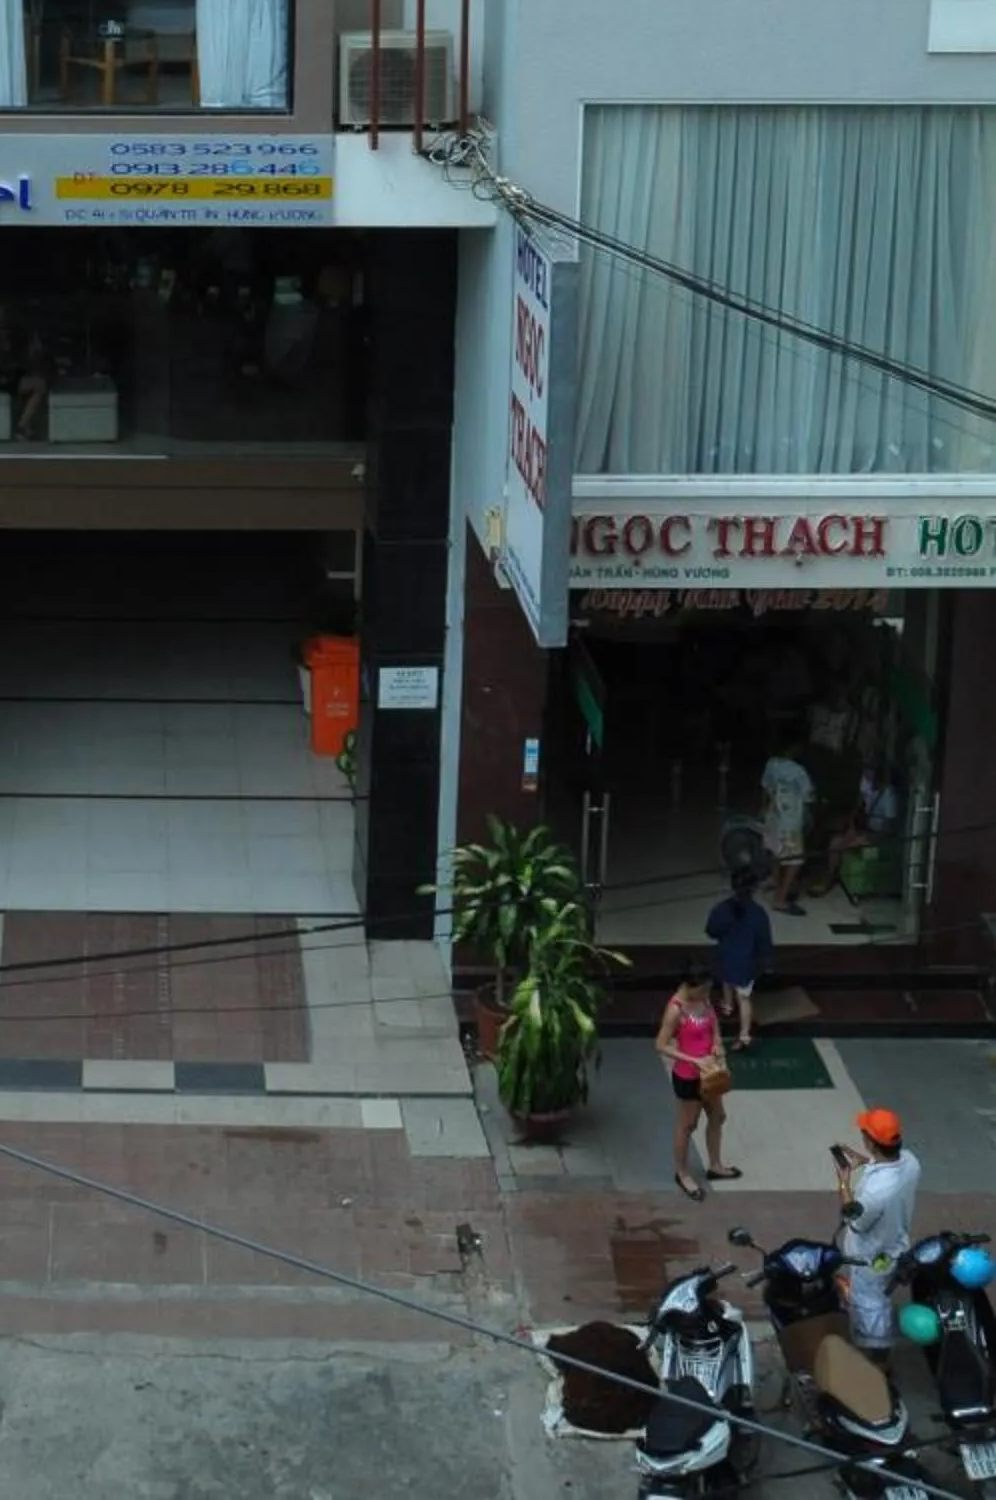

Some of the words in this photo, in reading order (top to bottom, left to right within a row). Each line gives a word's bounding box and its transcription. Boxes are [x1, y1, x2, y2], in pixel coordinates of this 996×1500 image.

[192, 142, 253, 156] 523
[256, 142, 319, 156] 966
[110, 162, 181, 176] 0913
[187, 160, 253, 176] 286
[257, 160, 321, 176] 446
[569, 514, 692, 567] GỌC
[708, 514, 887, 567] THẠCH
